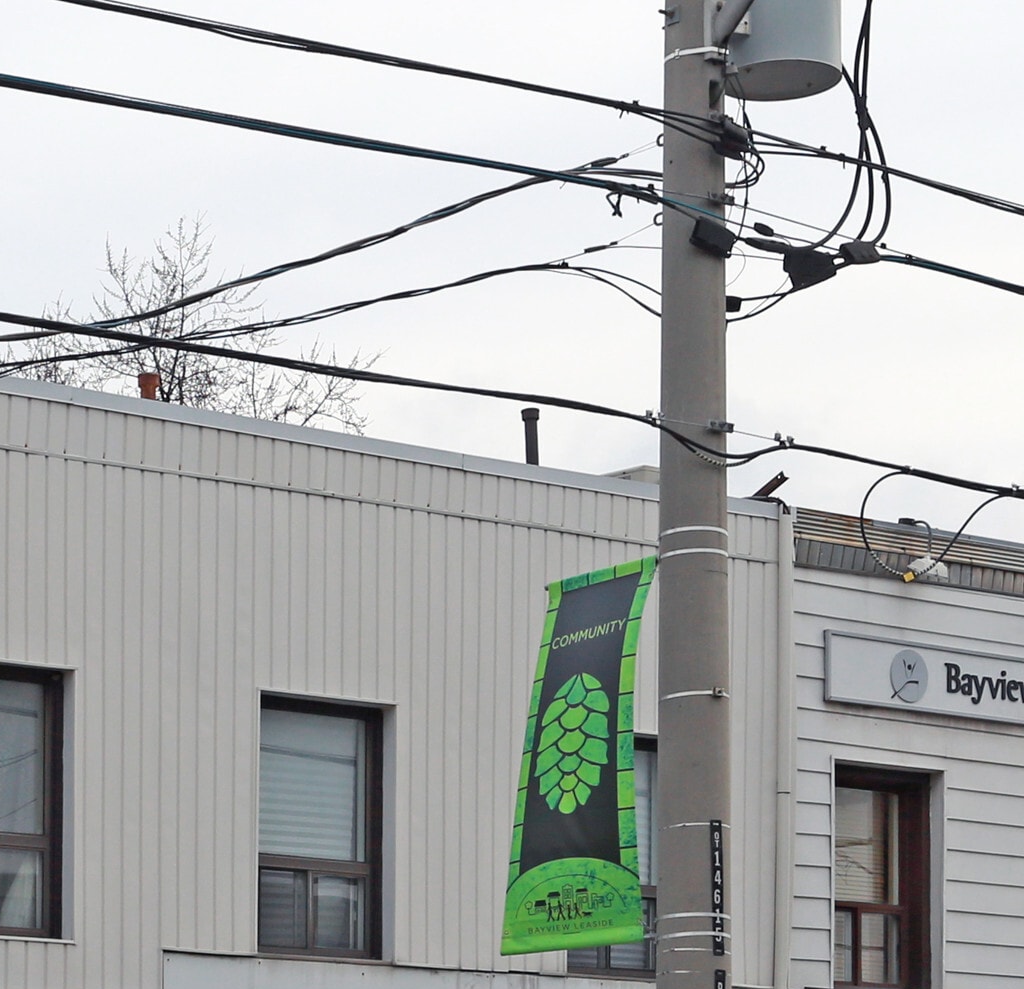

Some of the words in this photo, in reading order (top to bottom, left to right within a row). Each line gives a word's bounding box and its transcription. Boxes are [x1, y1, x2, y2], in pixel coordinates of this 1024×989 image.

[551, 618, 626, 650] COMMUNITY
[527, 923, 571, 936] BAYVIEW
[575, 918, 615, 931] LEASIDE
